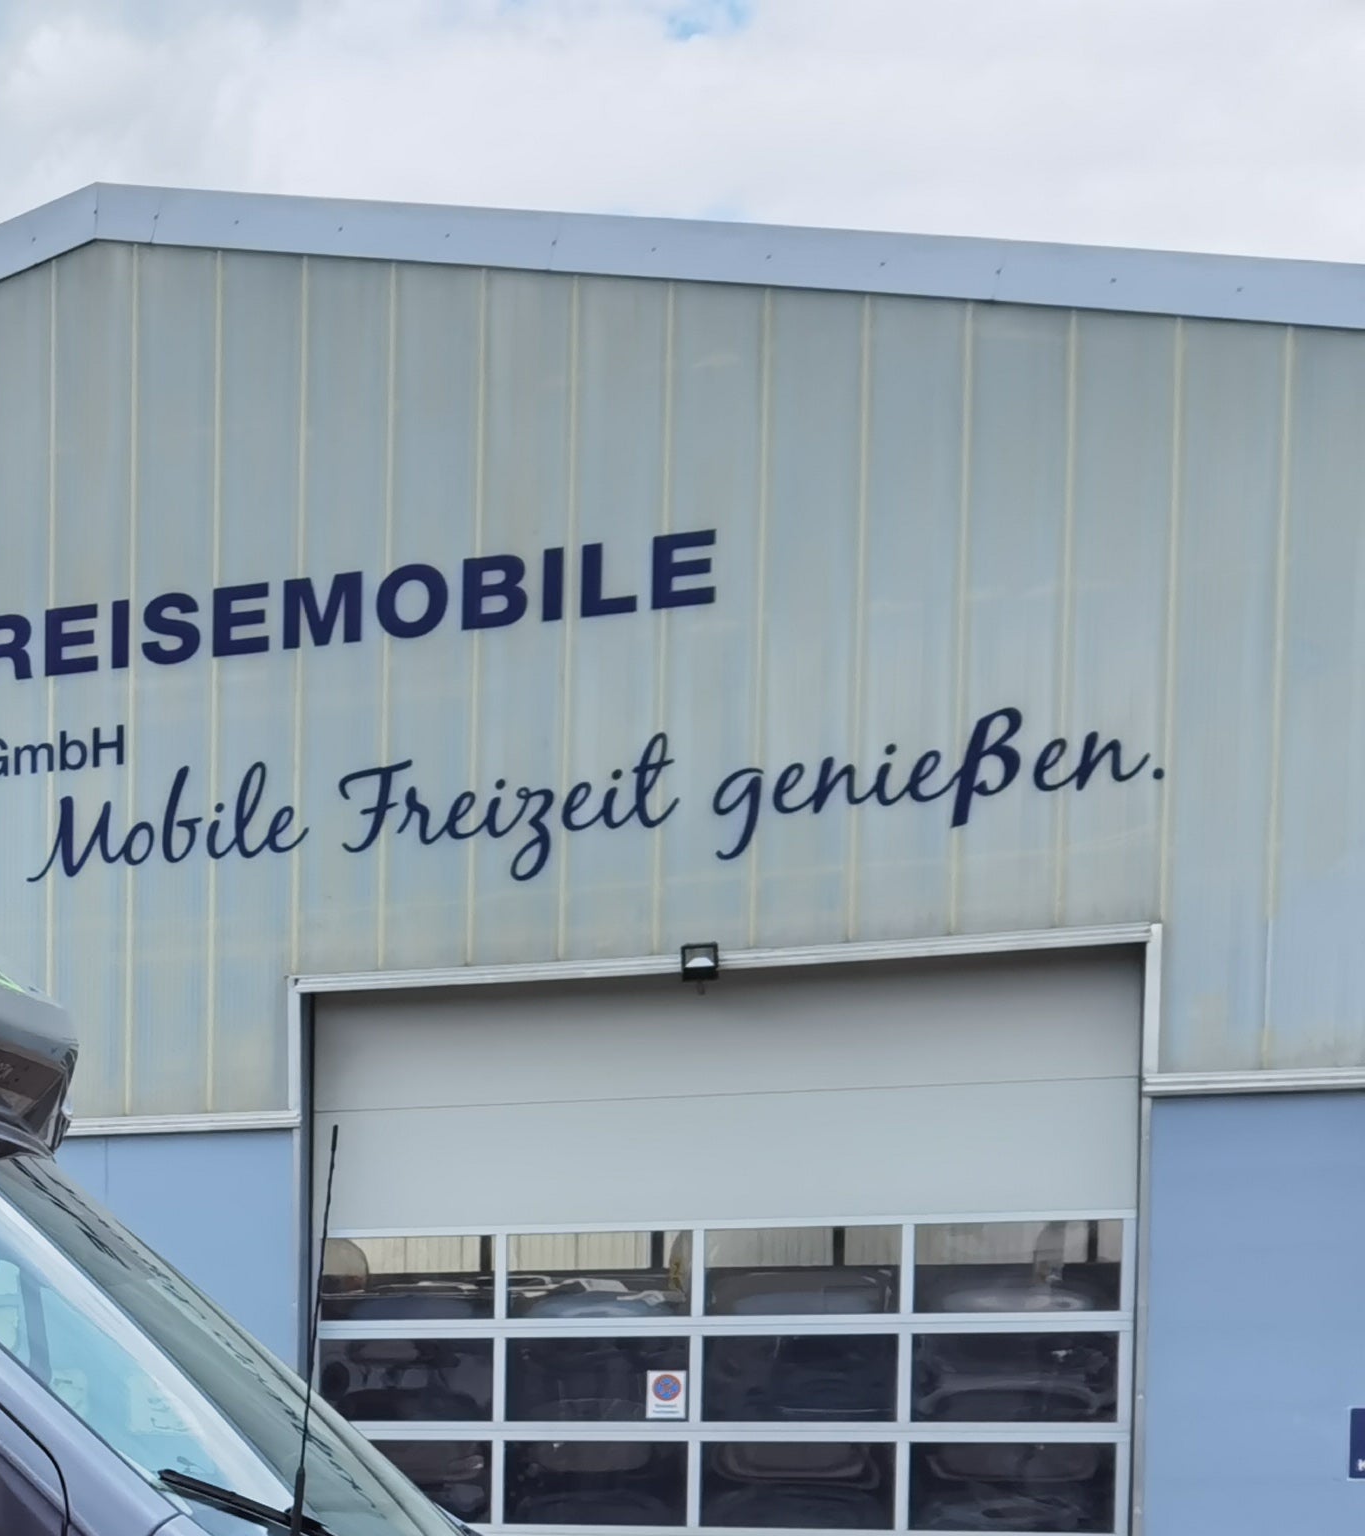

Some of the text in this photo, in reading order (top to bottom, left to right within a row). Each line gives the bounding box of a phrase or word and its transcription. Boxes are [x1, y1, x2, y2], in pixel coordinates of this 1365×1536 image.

[26, 706, 1166, 882] Mobile Freizeit genießen.
